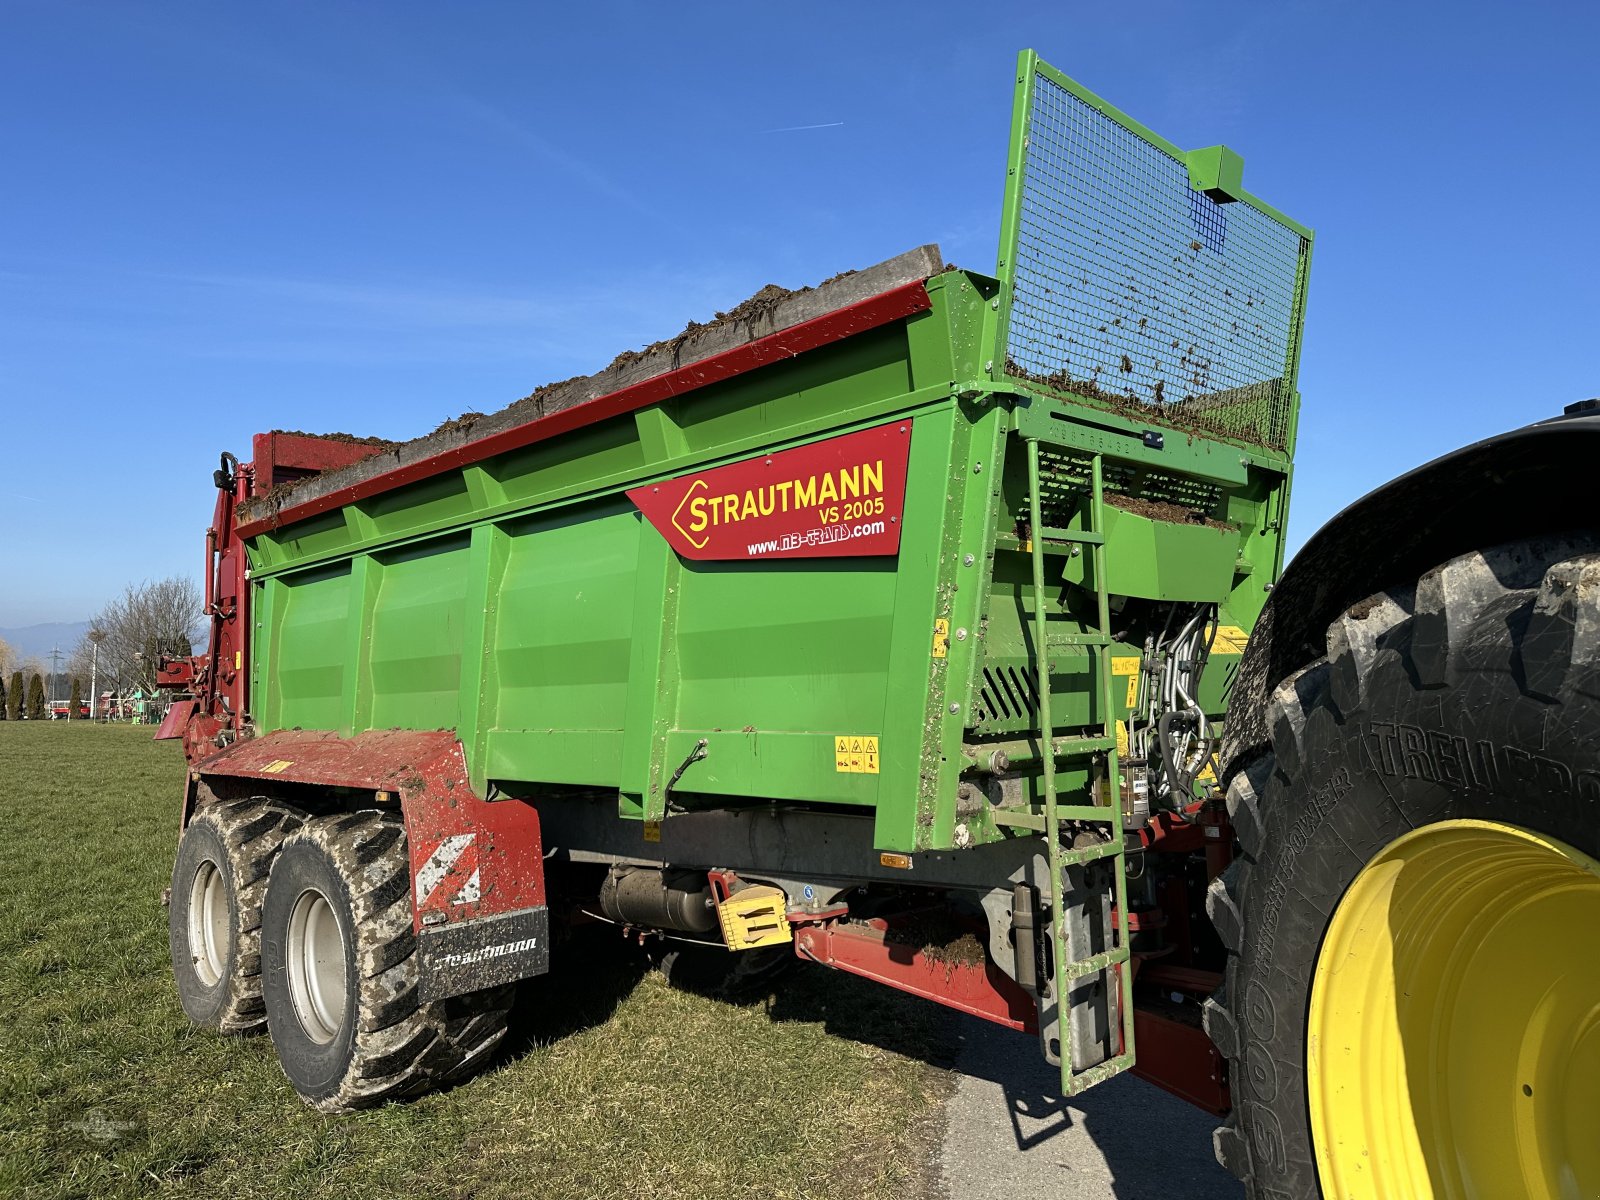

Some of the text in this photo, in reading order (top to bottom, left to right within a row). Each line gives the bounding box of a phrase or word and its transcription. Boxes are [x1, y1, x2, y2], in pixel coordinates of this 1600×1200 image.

[689, 460, 884, 532] STRAUTMANN
[819, 496, 885, 525] VS 2005
[1278, 766, 1355, 881] POWER
